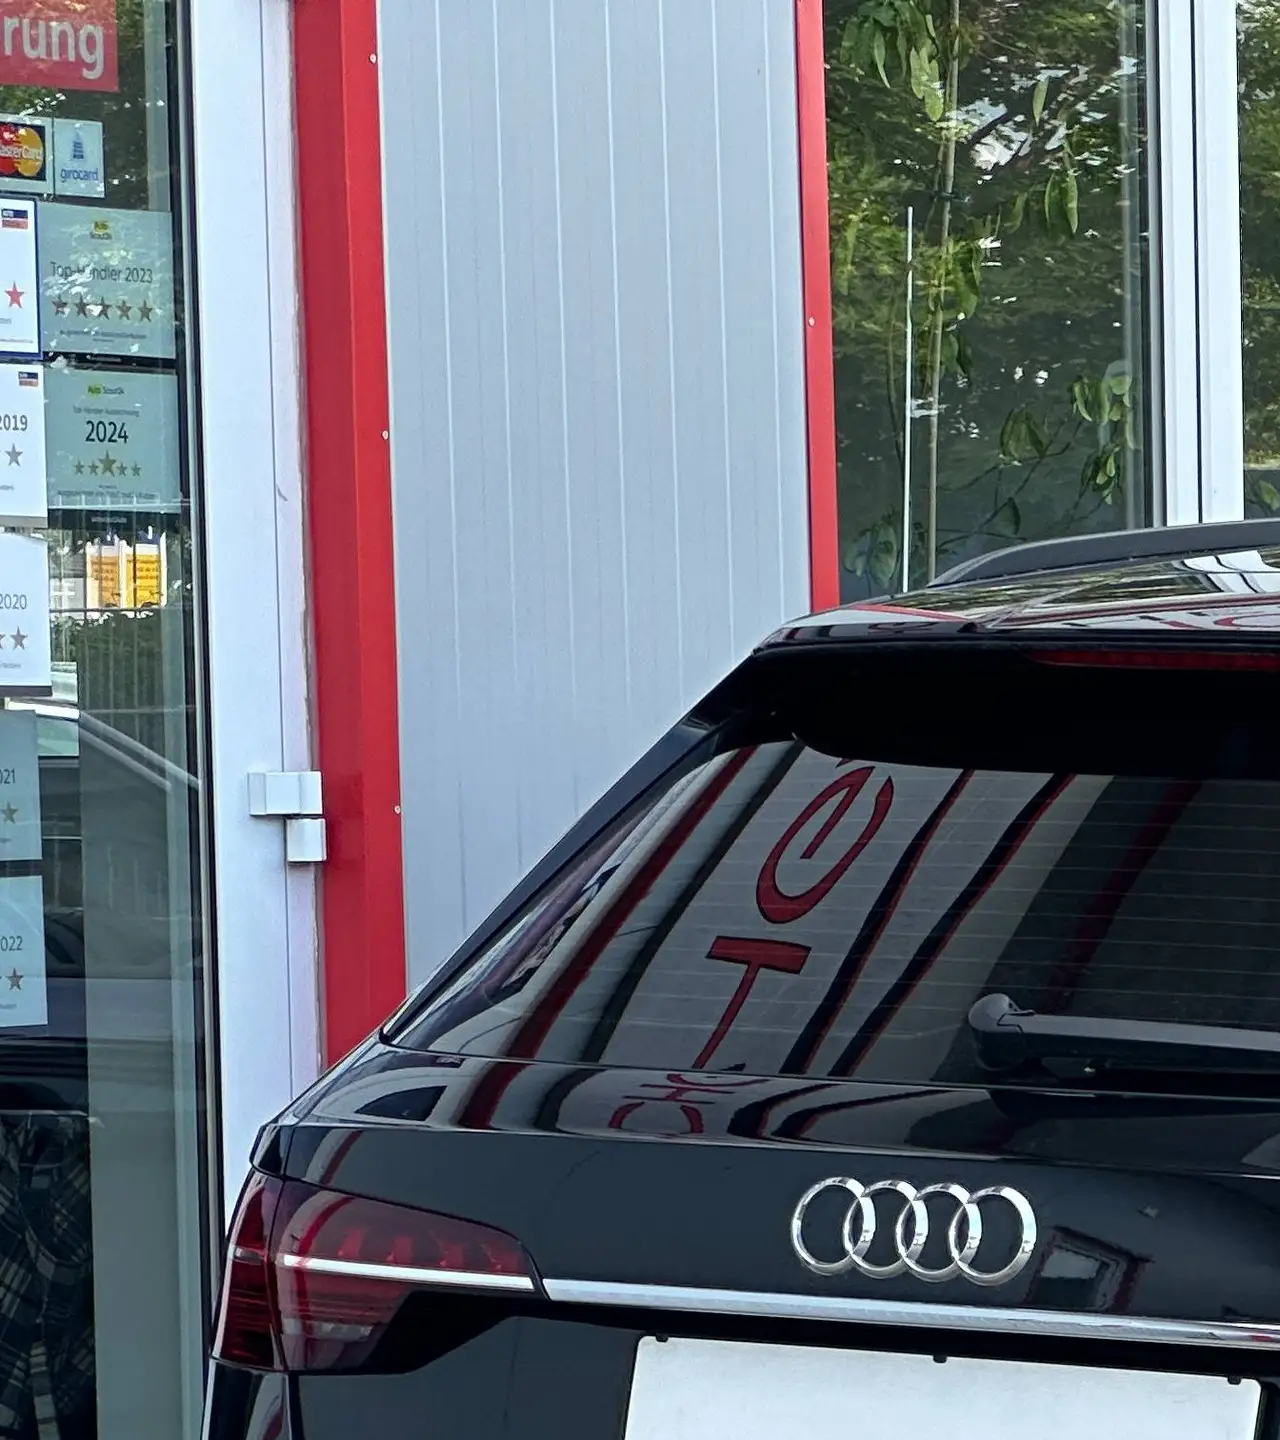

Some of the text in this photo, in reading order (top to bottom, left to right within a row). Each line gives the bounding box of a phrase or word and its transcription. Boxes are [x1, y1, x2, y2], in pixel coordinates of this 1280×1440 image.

[3, 15, 105, 80] rung
[124, 268, 153, 284] 2023
[85, 420, 129, 444] 2024
